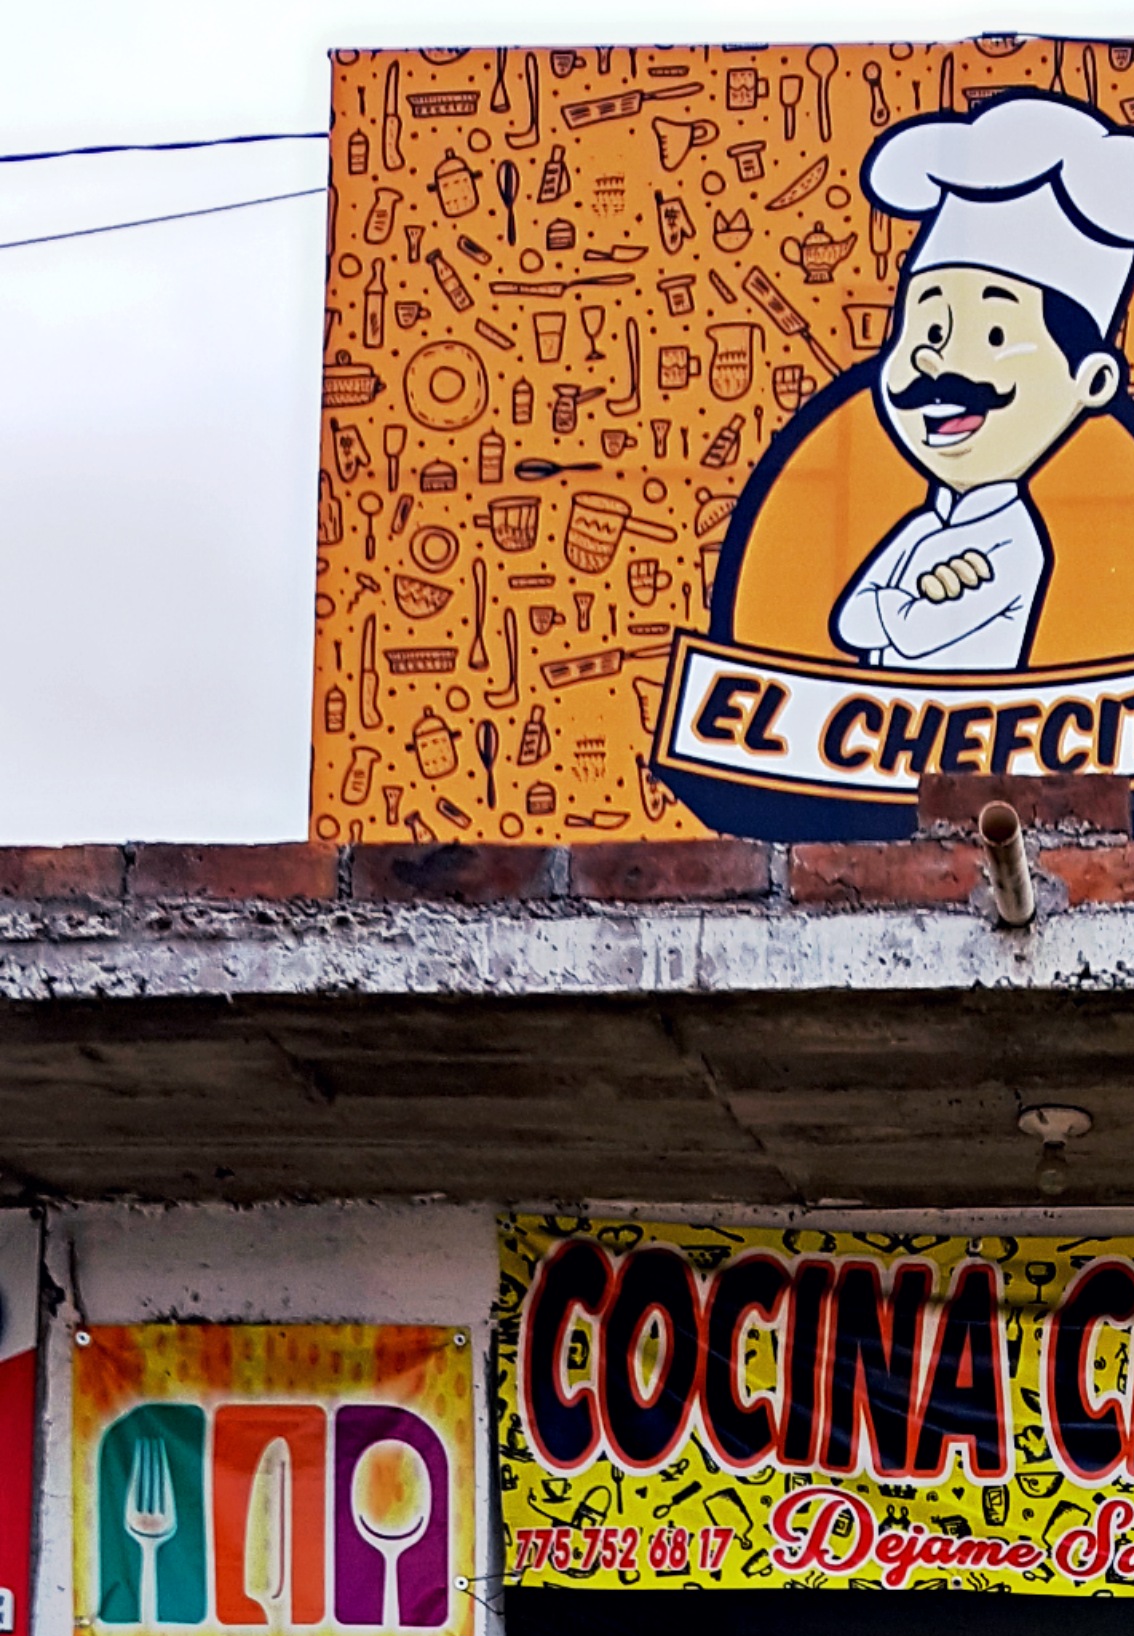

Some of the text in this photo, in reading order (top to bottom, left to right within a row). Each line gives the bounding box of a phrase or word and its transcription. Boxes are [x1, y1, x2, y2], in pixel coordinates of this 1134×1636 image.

[697, 674, 790, 753] EL
[520, 1238, 1010, 1481] COCINA
[514, 1527, 734, 1571] 775 752 68 17
[771, 1486, 1043, 1588] Dejame
